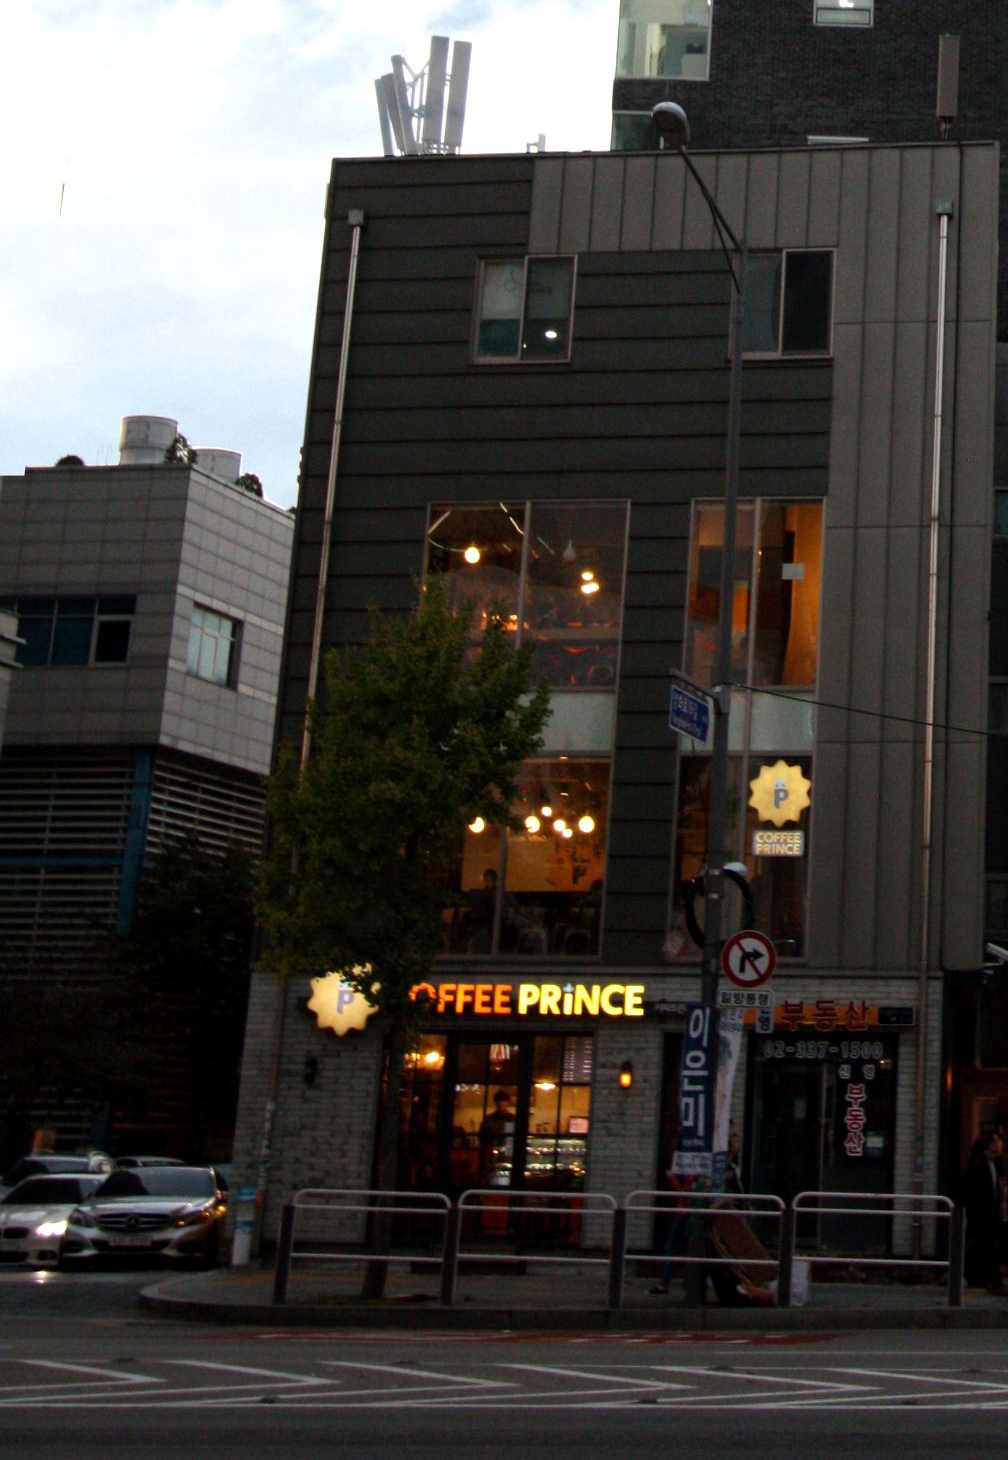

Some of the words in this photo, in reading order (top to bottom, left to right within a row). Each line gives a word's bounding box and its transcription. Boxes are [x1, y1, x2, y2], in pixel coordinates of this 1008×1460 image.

[774, 788, 789, 809] P
[756, 832, 801, 843] COFFEE
[336, 988, 354, 1015] P
[408, 982, 513, 1014] OFFEE
[721, 992, 769, 1006] 일방통행
[781, 1000, 869, 1032] 부동산
[844, 1083, 867, 1157] 부동산
